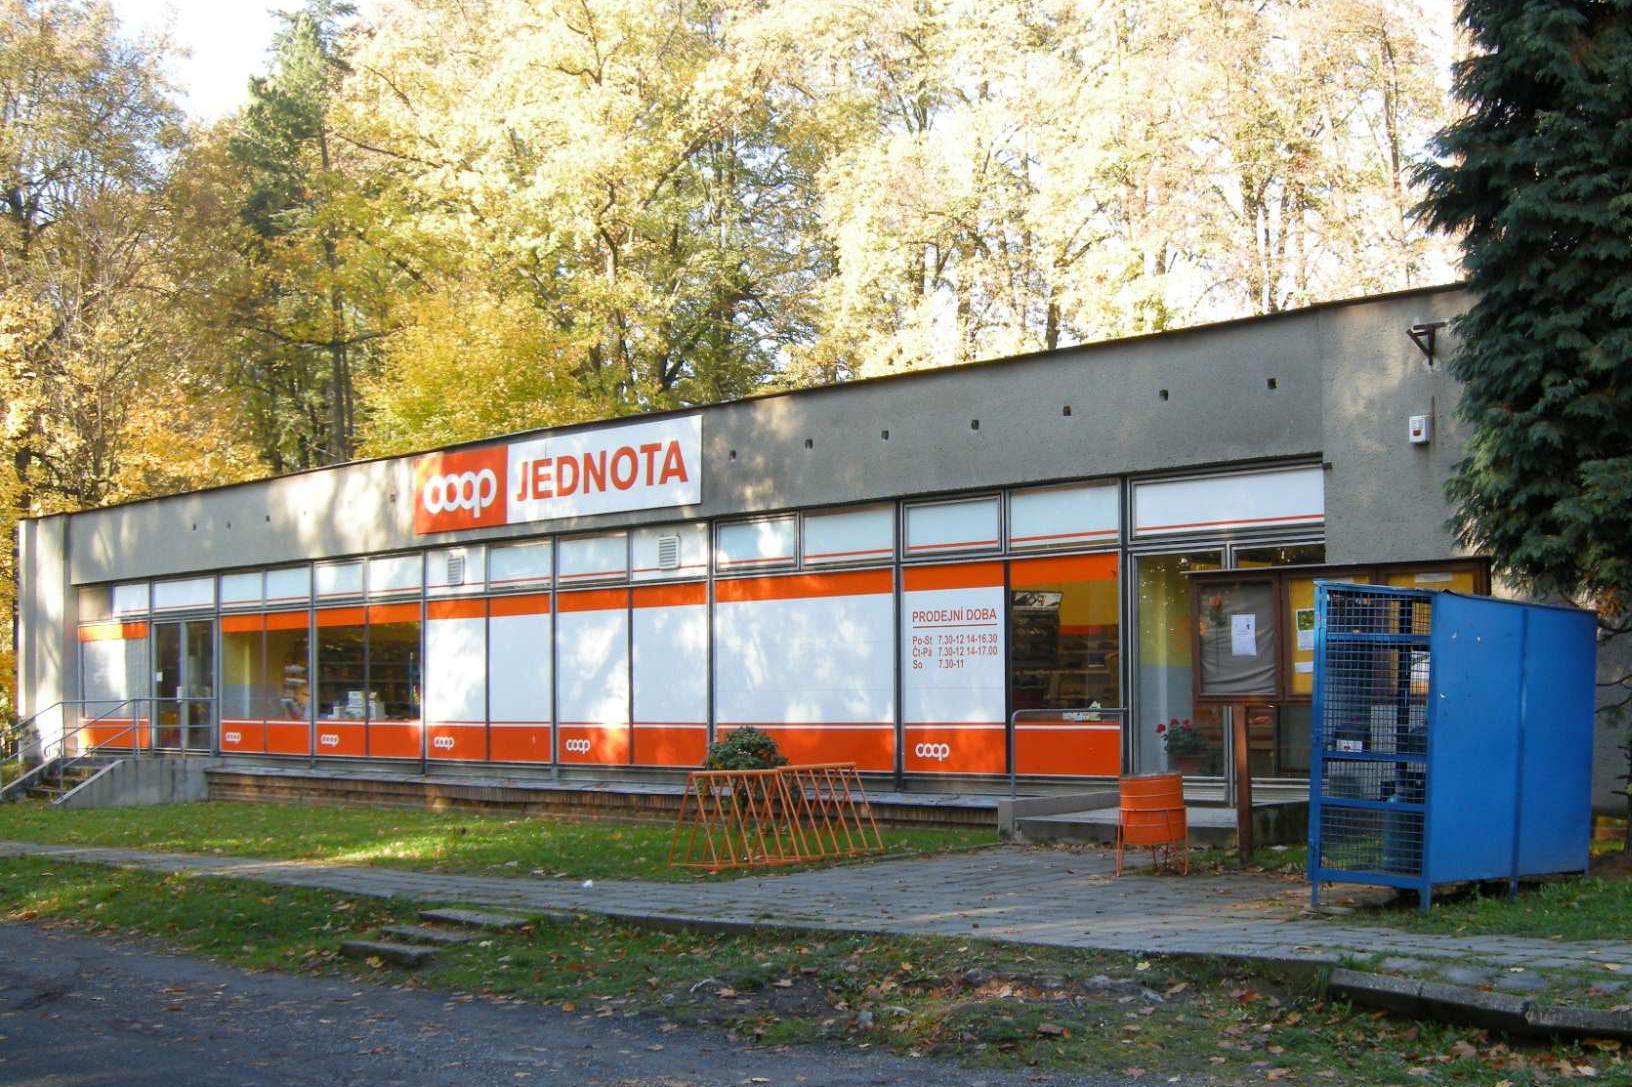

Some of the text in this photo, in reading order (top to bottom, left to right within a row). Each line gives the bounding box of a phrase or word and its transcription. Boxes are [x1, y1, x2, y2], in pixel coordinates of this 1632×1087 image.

[423, 440, 689, 518] coop JEDNOTA
[912, 606, 997, 622] PRODEJNÍ DOBA
[912, 635, 933, 646] Po-St
[912, 659, 923, 670] So
[566, 738, 591, 754] coop
[915, 743, 950, 761] coop
